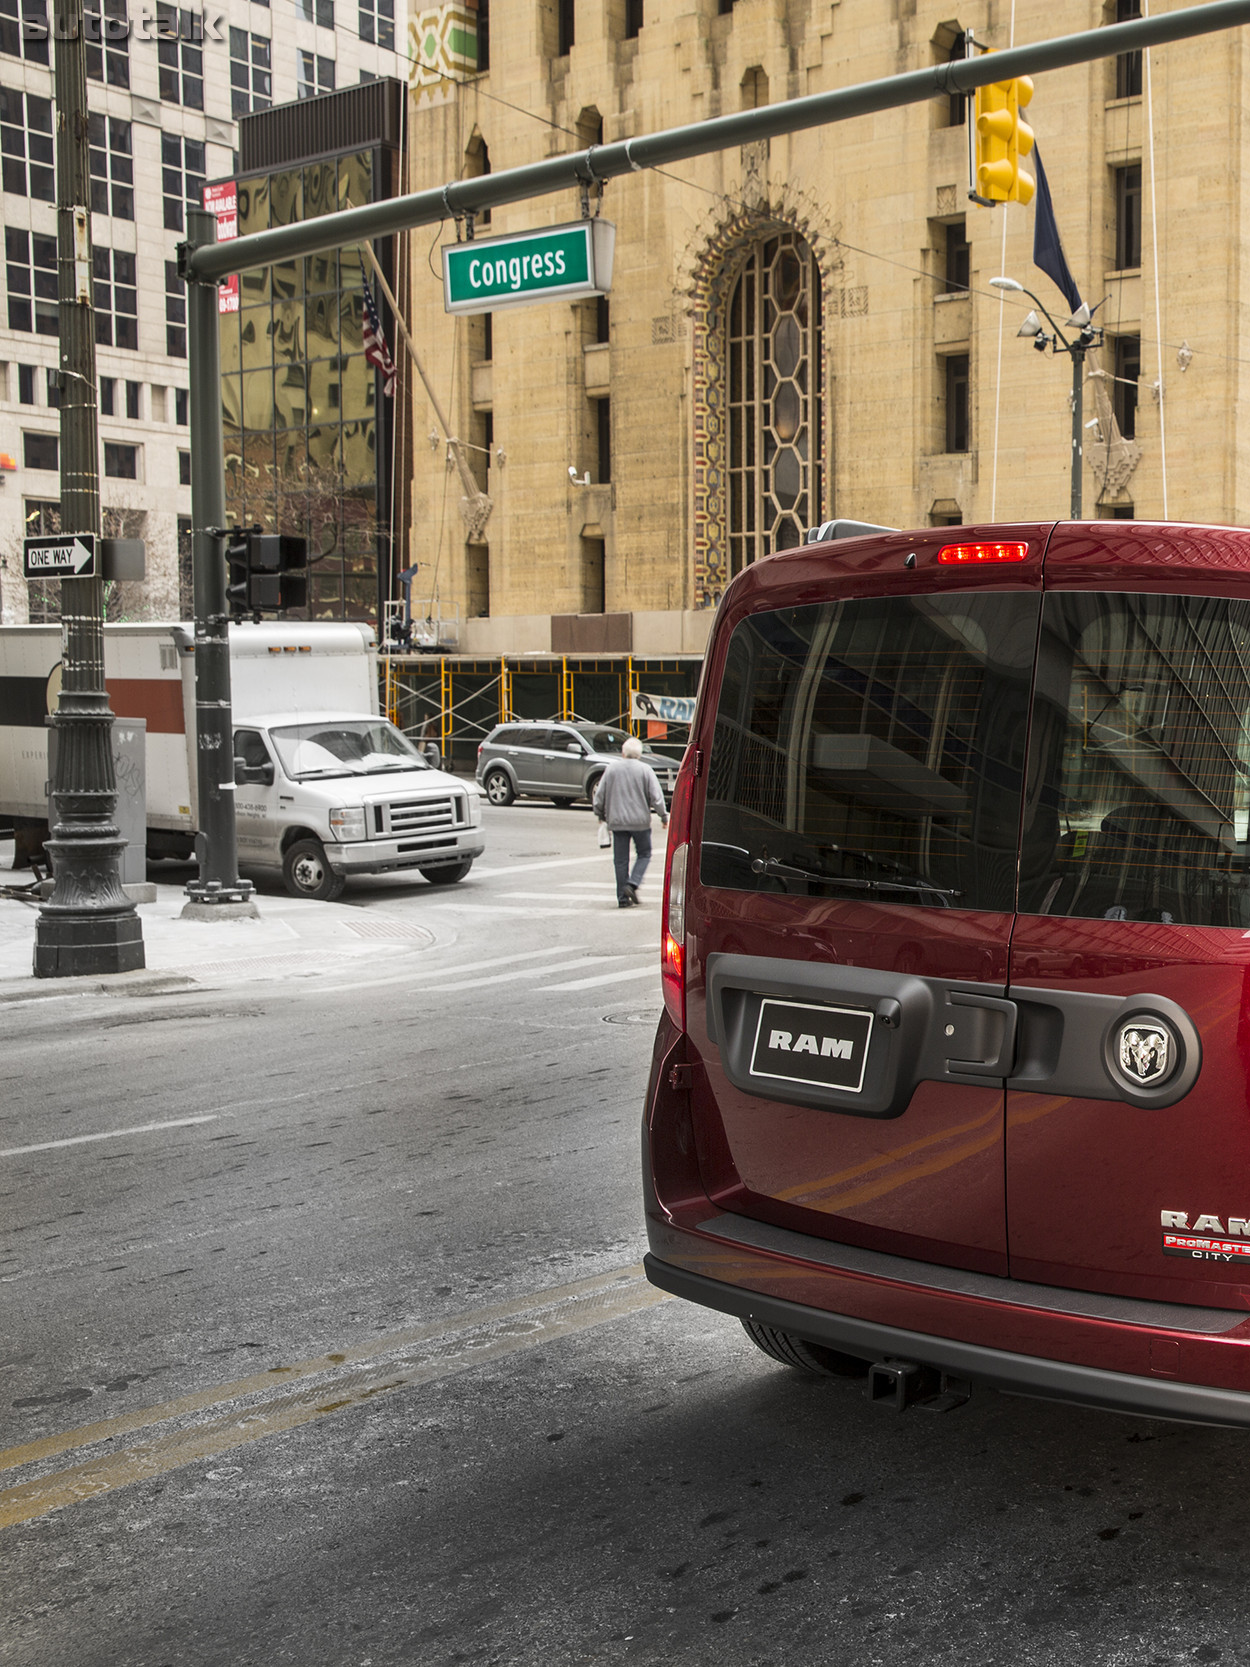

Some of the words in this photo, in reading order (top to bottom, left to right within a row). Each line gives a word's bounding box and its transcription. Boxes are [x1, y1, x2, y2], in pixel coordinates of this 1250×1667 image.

[469, 249, 566, 290] Congress
[30, 549, 50, 566] ONE
[52, 548, 73, 565] WAY
[768, 1029, 854, 1060] RAM
[1191, 1250, 1233, 1261] CITY
